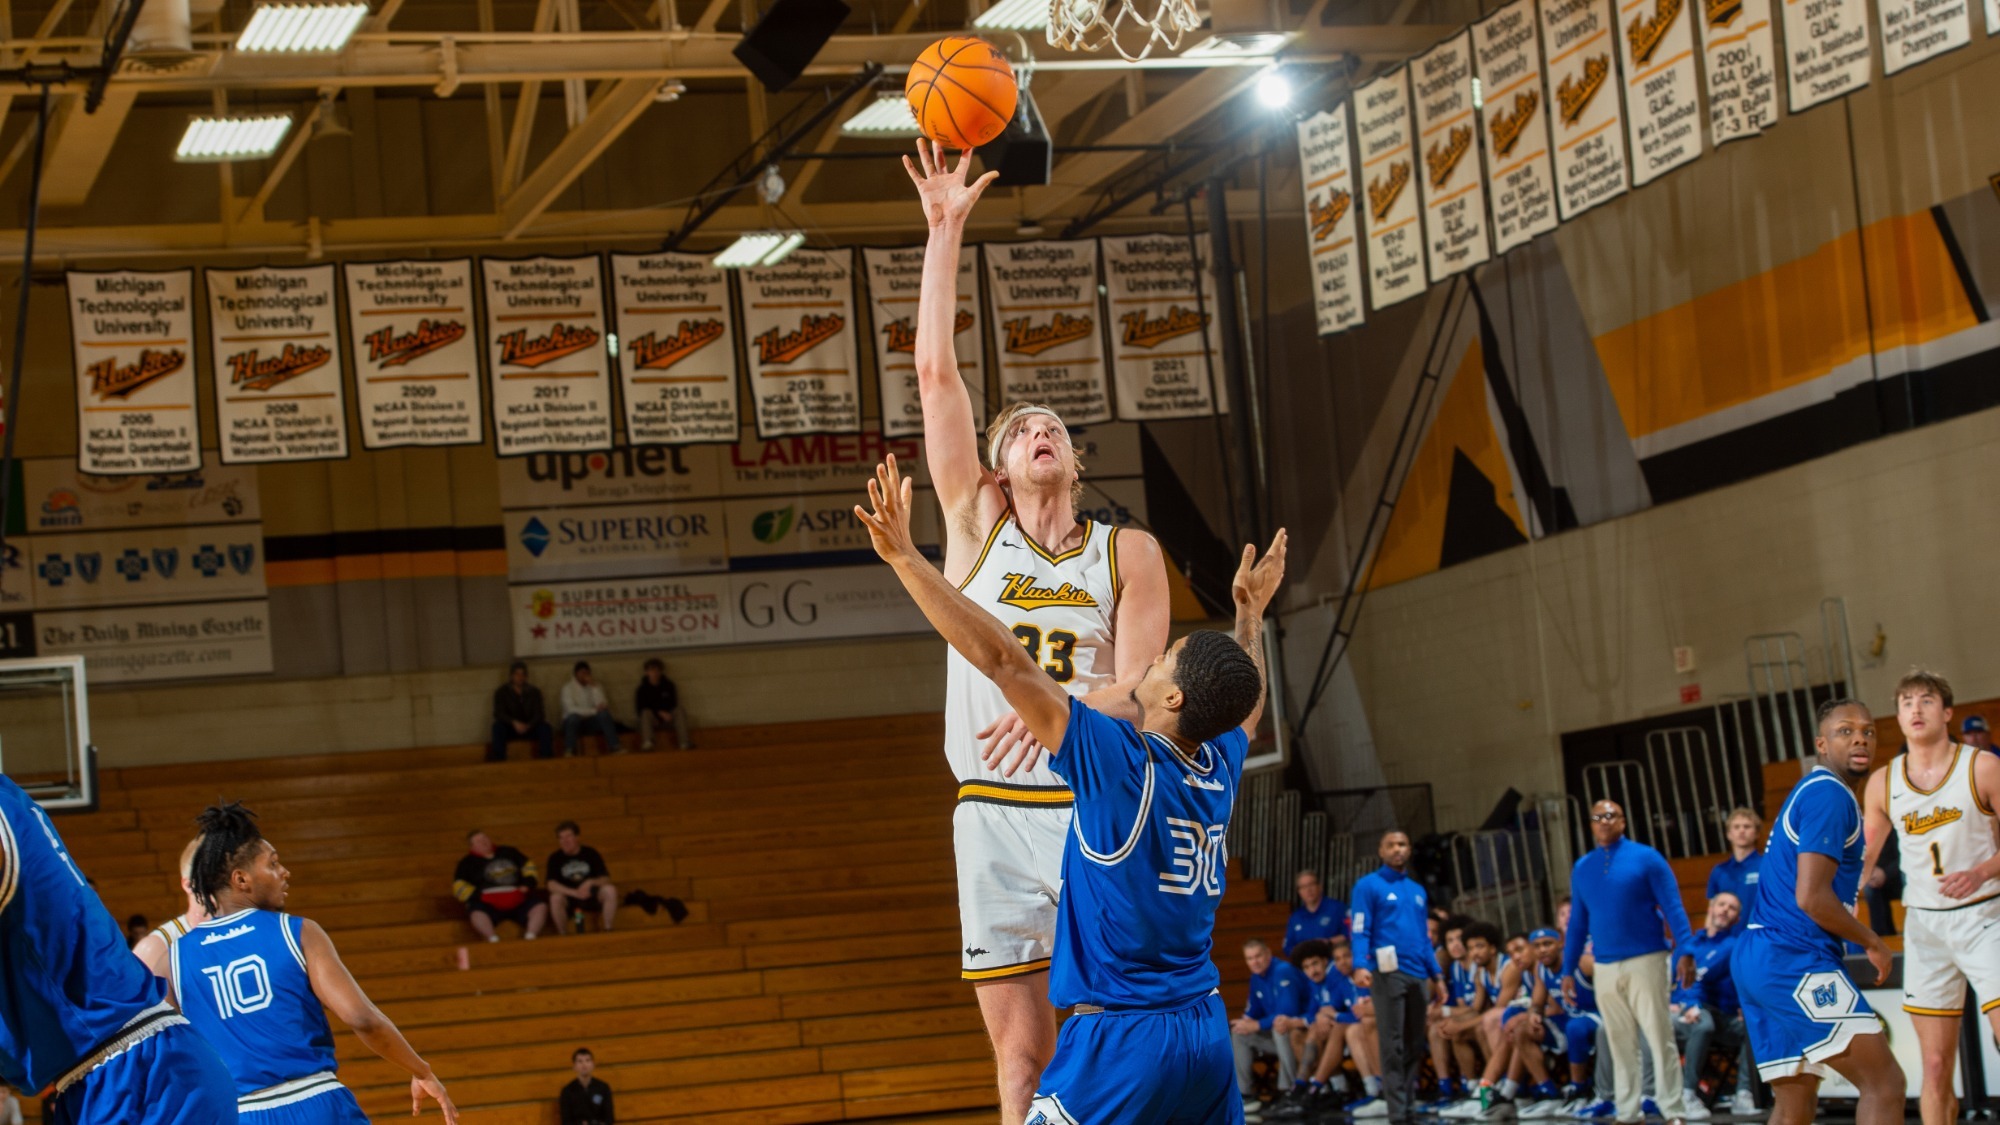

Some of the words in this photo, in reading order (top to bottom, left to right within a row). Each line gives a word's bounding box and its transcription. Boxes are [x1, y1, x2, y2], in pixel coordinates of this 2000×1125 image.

[1902, 30, 1948, 57] Champions
[1009, 247, 1075, 262] Michigan
[1126, 240, 1191, 256] Michigan
[375, 265, 442, 279] Michigan
[509, 265, 574, 277] Michigan
[638, 259, 702, 271] Michigan
[994, 263, 1093, 280] Technological
[235, 275, 307, 292] Michigan
[621, 272, 722, 287] Technological
[747, 269, 845, 284] Technological
[96, 278, 166, 293] Michigan
[357, 279, 463, 293] Technological
[493, 278, 594, 293] Technological
[760, 286, 832, 299] University
[1010, 284, 1081, 301] University
[1126, 278, 1196, 294] University
[218, 292, 327, 312] Technological
[373, 293, 448, 305] University
[507, 294, 581, 307] University
[636, 290, 707, 303] University
[78, 294, 184, 317] Technological
[94, 319, 171, 336] University
[235, 313, 314, 330] University
[752, 313, 845, 363] Huskies
[1002, 312, 1094, 355] Huskies
[363, 319, 466, 367] Huskies
[496, 323, 600, 367] Huskies
[628, 318, 724, 367] Huskies
[227, 344, 331, 388] Huskies
[1152, 359, 1186, 371] 2021
[86, 349, 186, 397] Huskies
[1036, 368, 1069, 379] 2021
[1152, 373, 1190, 384] GLIAC
[533, 386, 570, 398] 2017
[660, 386, 702, 399] 2018
[787, 379, 825, 392] 2019
[1007, 383, 1038, 394] NCAA
[1041, 381, 1089, 392] DIVISION
[1144, 386, 1199, 398] Champions
[634, 402, 666, 412] NCAA
[671, 400, 717, 410] Division
[763, 395, 792, 405] NCAA
[799, 393, 841, 403] Division
[374, 402, 407, 413] NCAA
[411, 401, 454, 411] Division
[507, 404, 540, 415] NCAA
[543, 402, 586, 413] Division
[233, 418, 268, 429] NCAA
[274, 416, 321, 427] Division
[763, 419, 805, 430] Women's
[811, 416, 856, 428] Volleyball
[90, 429, 122, 440] NCAA
[129, 428, 175, 439] Division
[377, 429, 417, 440] Women's
[418, 427, 468, 439] Volleyball
[503, 434, 551, 446] Women's
[554, 430, 607, 443] Volleyball
[633, 426, 678, 438] Women's
[682, 425, 734, 437] Volleyball
[232, 445, 282, 456] Women's
[287, 443, 339, 455] Volleyball
[91, 458, 136, 468] Women's
[142, 456, 191, 468] Volleyball
[735, 469, 759, 481] The
[764, 465, 828, 481] Passenger
[633, 481, 692, 496] Telephone
[558, 514, 709, 545] SUPERIOR
[579, 544, 647, 555] NATIONAL
[654, 540, 690, 550] BANK
[560, 587, 615, 603] SUPER
[621, 587, 630, 598] 8
[636, 584, 692, 599] MOTEL
[44, 626, 75, 645] The
[82, 625, 130, 642] Daily
[137, 621, 198, 639] Mining
[202, 616, 263, 635] Gazette
[555, 613, 720, 638] MAGNUSON
[1010, 622, 1079, 685] 33
[1901, 806, 1963, 835] Huskies
[1158, 816, 1224, 896] 30
[1929, 841, 1945, 876] 1
[201, 954, 273, 1020] 10
[1812, 981, 1838, 1008] GV
